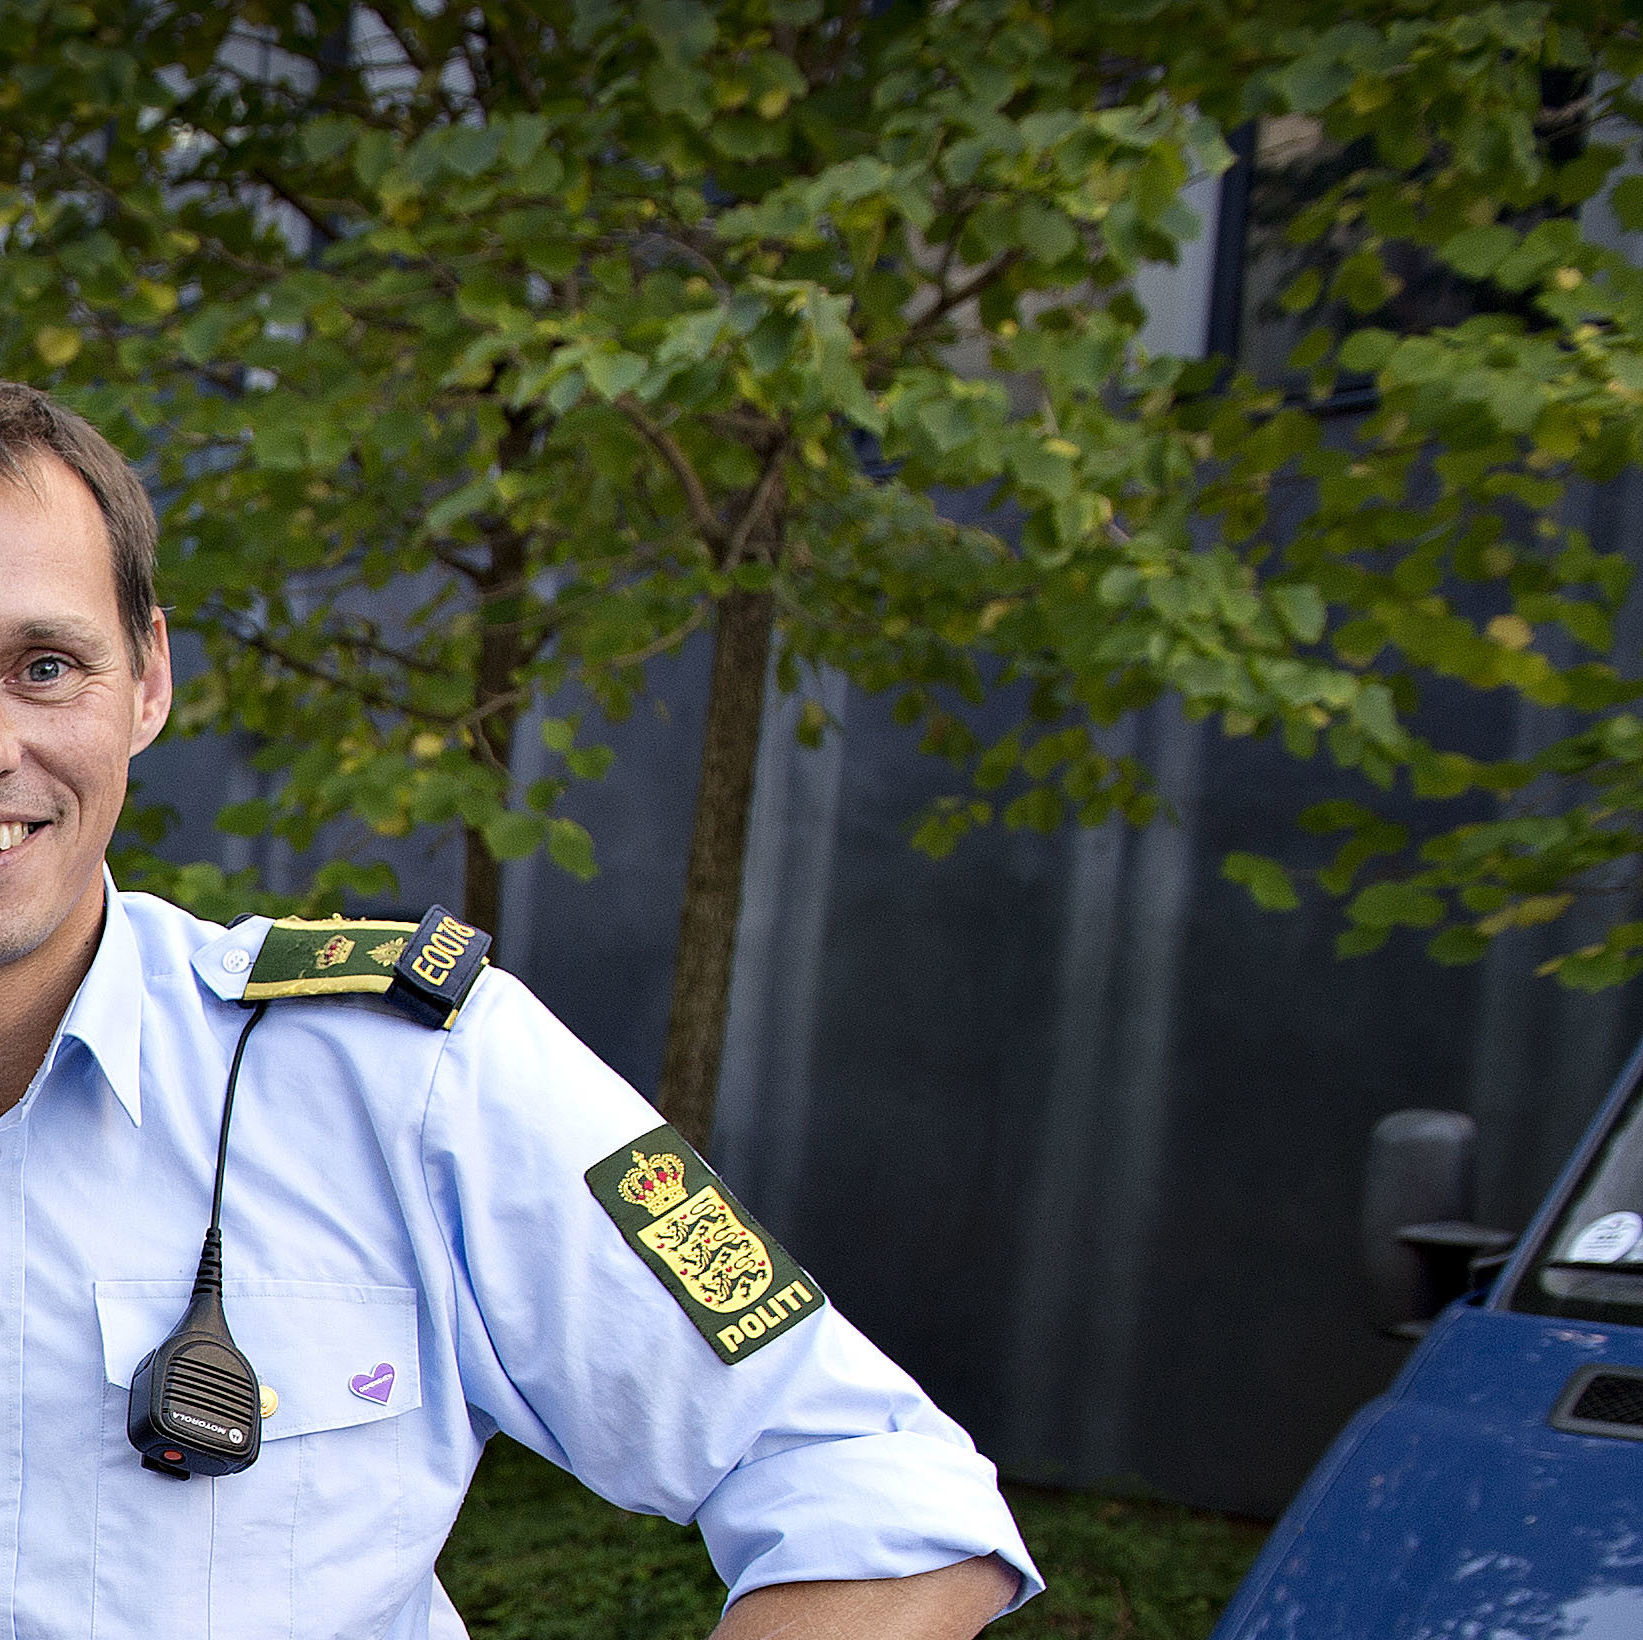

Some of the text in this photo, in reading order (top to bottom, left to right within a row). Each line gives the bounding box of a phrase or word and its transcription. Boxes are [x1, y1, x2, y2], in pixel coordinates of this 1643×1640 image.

[411, 916, 476, 987] E0078
[716, 1279, 814, 1354] POLITI
[172, 1411, 228, 1435] MOTOROLA
